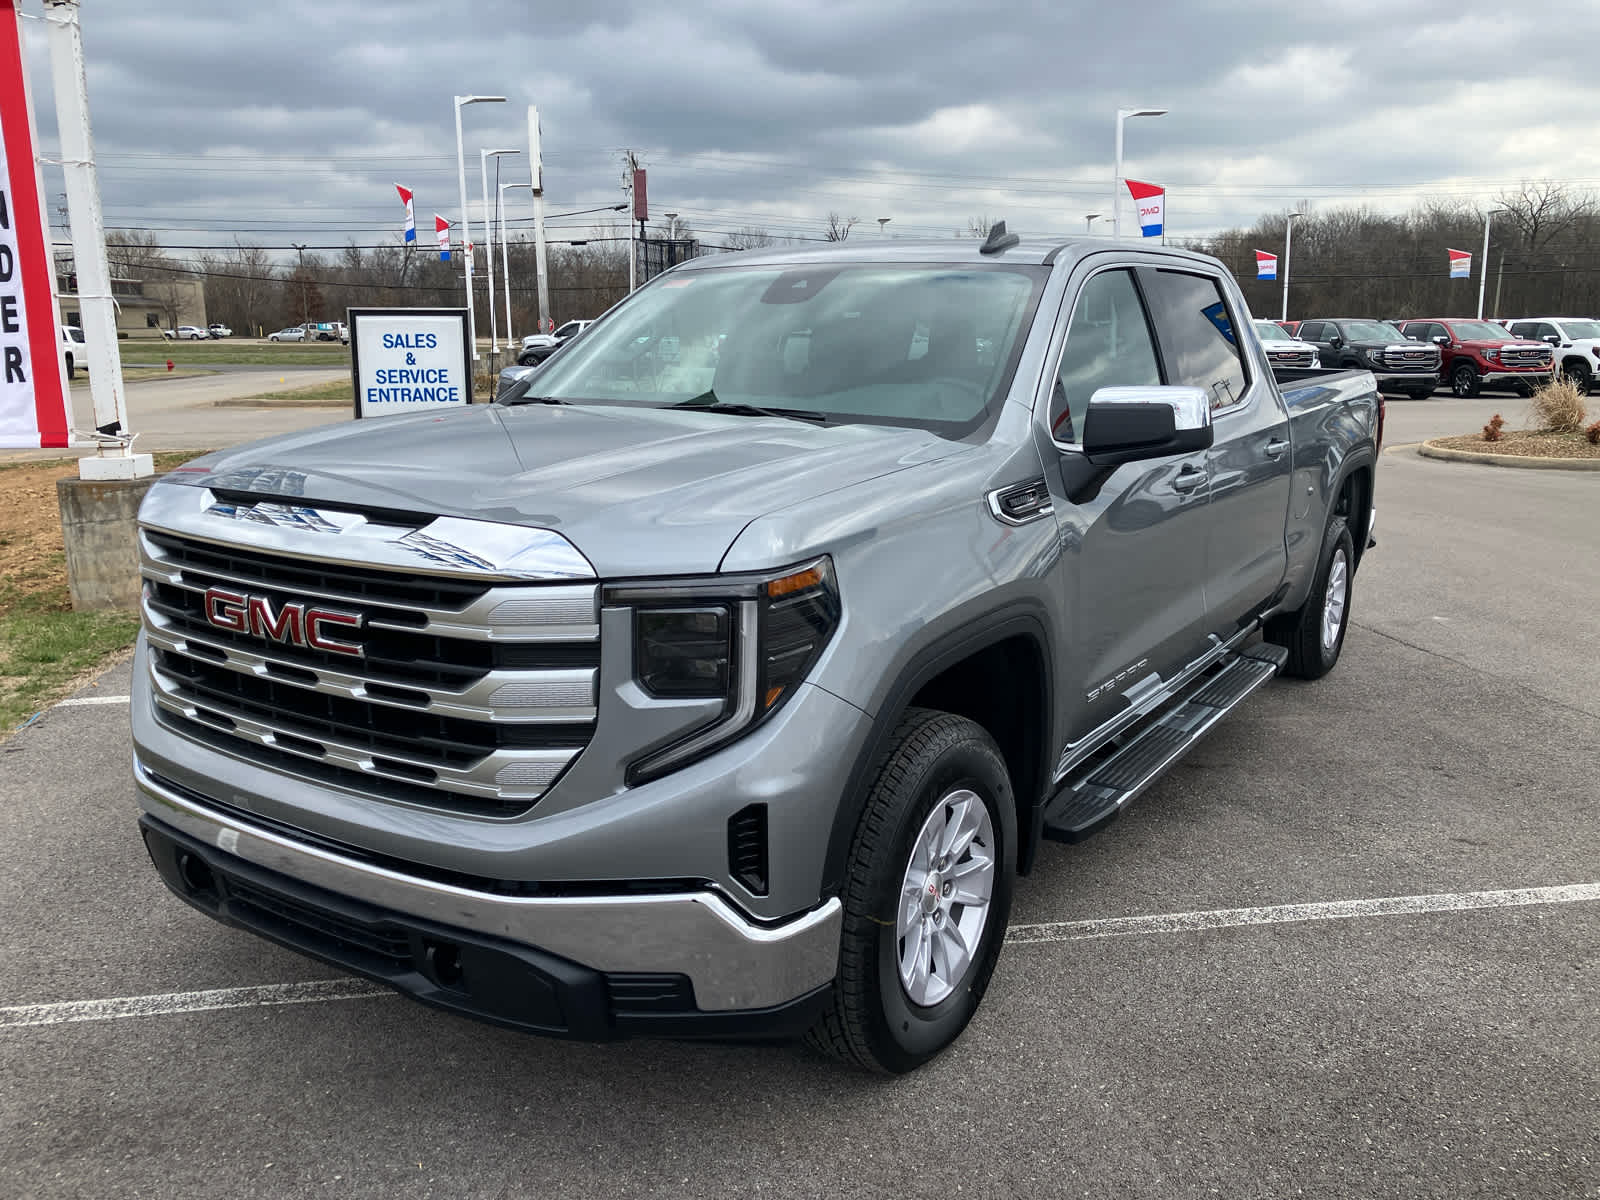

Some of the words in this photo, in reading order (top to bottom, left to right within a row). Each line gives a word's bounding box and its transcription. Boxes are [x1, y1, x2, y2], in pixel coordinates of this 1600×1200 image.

[383, 333, 437, 348] SALES
[406, 352, 416, 366] &
[376, 369, 448, 384] SERVICE
[367, 387, 459, 403] ENTRANCE
[204, 587, 366, 659] GMC
